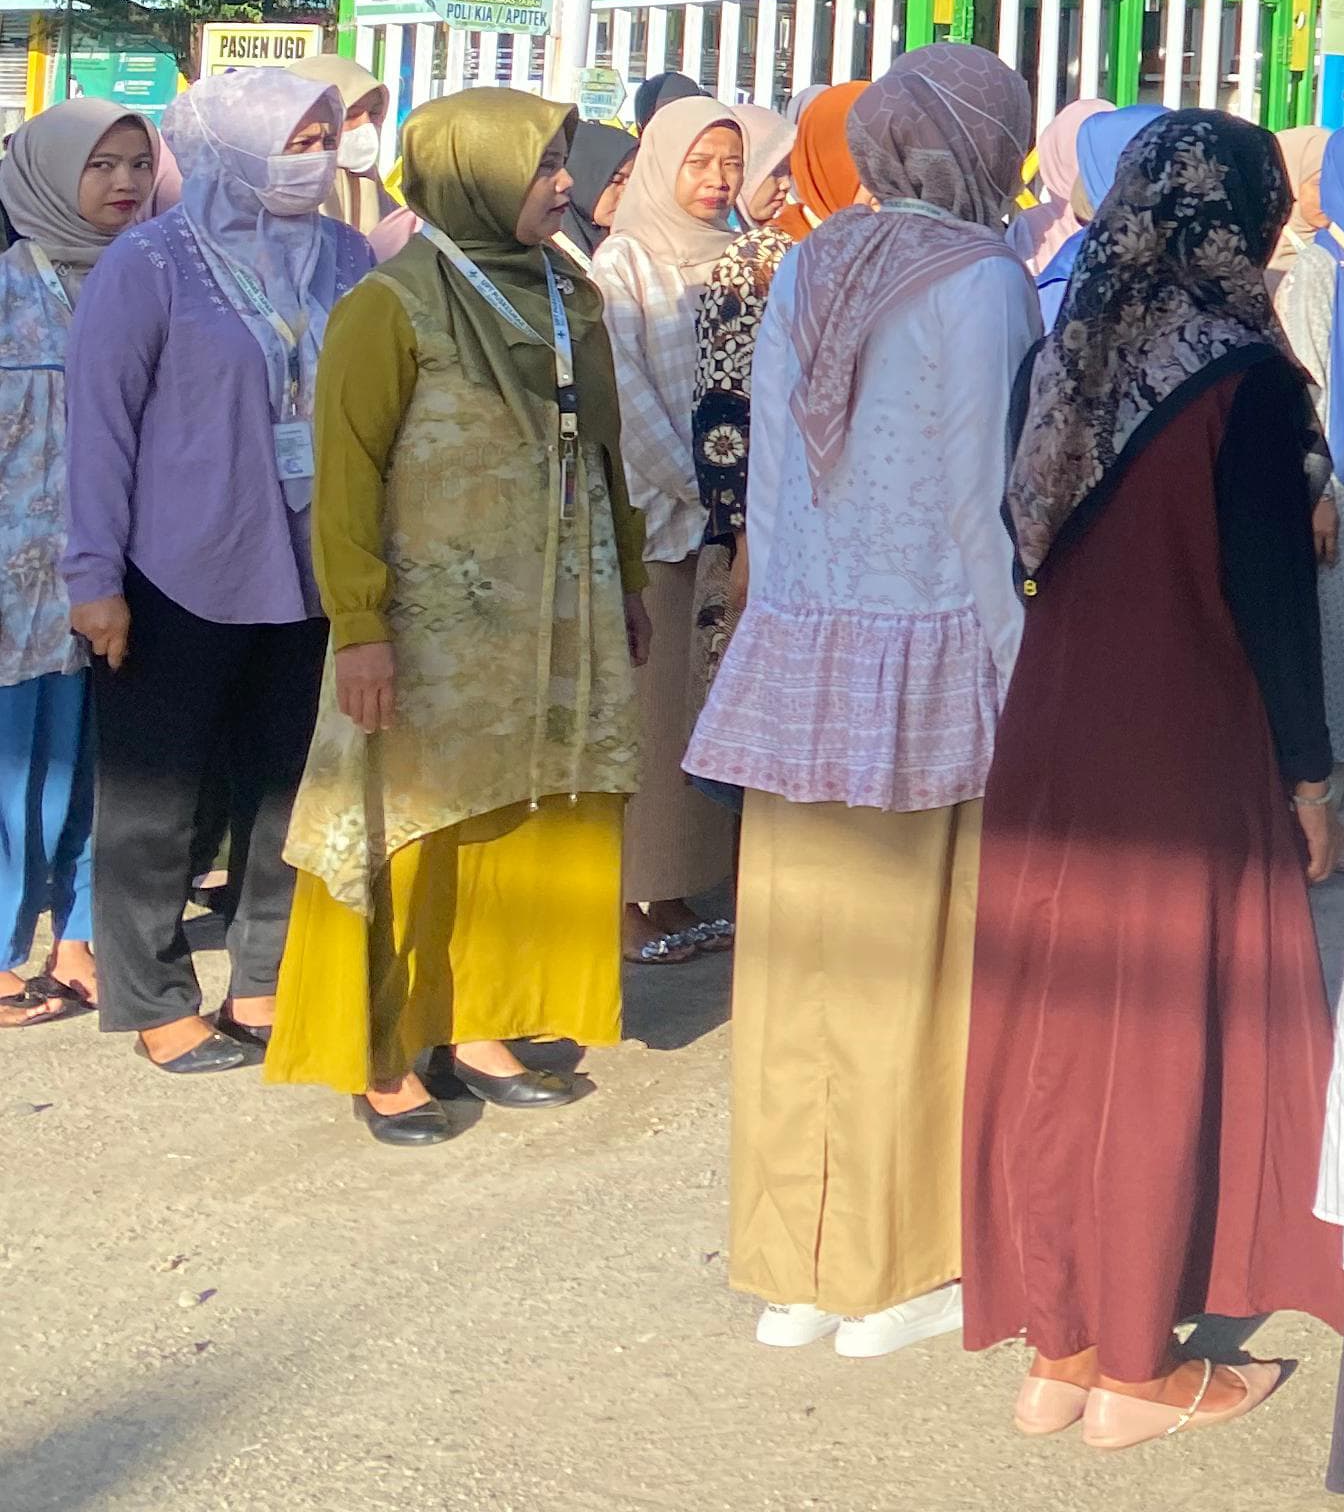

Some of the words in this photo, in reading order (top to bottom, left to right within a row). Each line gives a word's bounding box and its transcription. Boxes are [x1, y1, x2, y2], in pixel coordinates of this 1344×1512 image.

[447, 3, 471, 20] POLI
[475, 5, 493, 22] KIA
[505, 8, 548, 26] APOTEK
[219, 35, 270, 59] PASIEN
[274, 36, 306, 60] UGD
